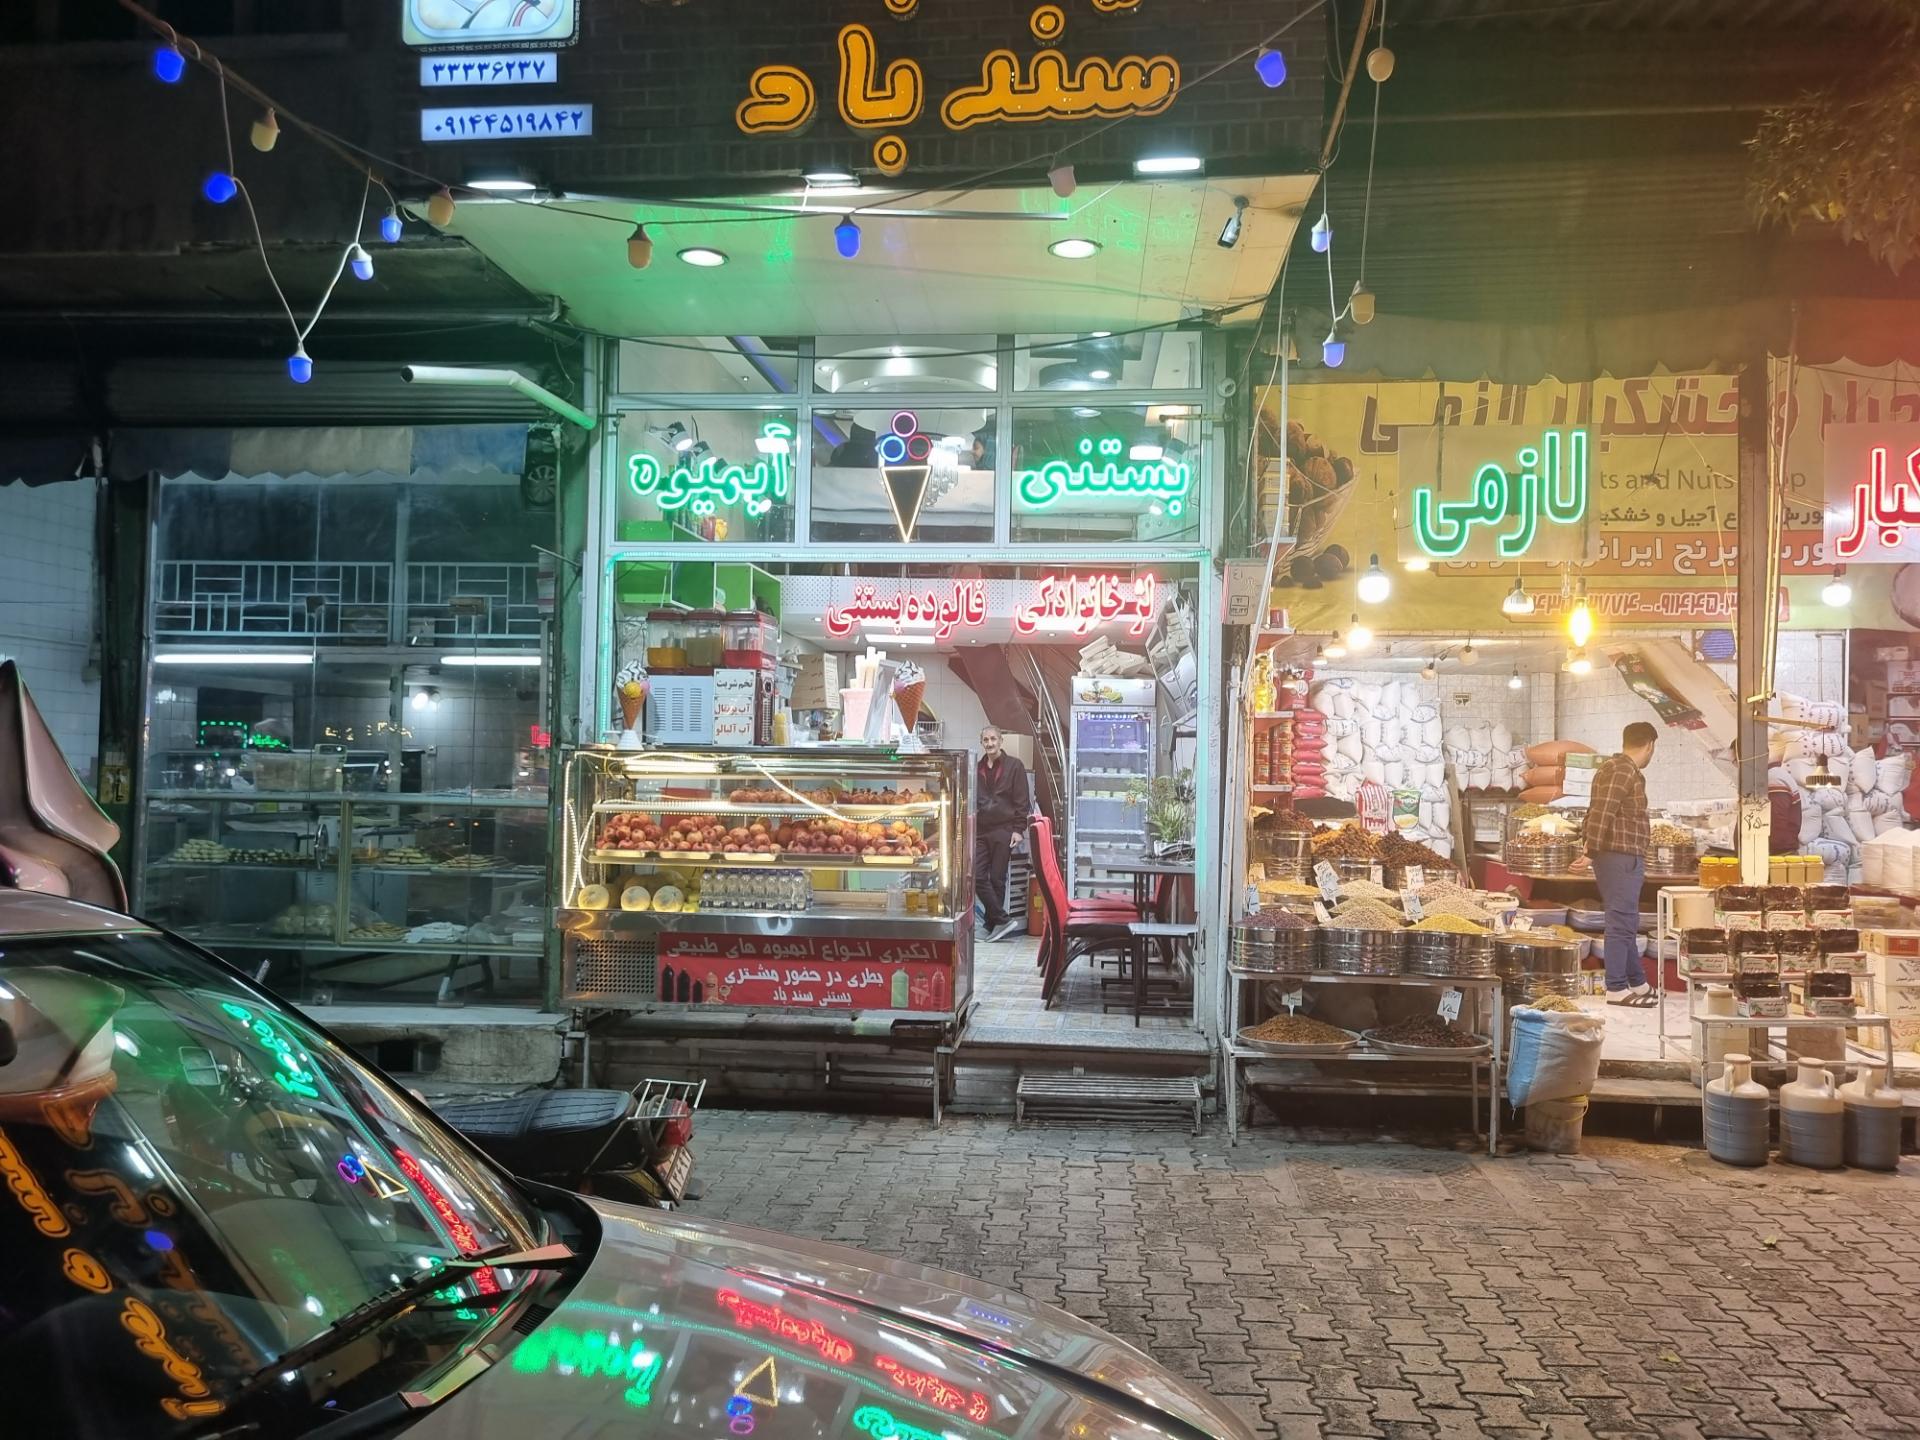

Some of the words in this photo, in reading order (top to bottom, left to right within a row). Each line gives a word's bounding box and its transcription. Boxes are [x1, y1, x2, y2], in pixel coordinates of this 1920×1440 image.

[435, 110, 583, 135] ۰۹۱۴۴۵۱۹۸۴۲
[1018, 438, 1192, 517] بستنی
[1413, 428, 1589, 558] لازمی
[739, 724, 751, 736] آب
[666, 936, 718, 957] طبیعی
[725, 937, 754, 958] های
[724, 963, 780, 985] مشتری
[783, 966, 821, 986] حضور
[825, 970, 843, 987] در
[847, 967, 884, 987] بطری
[818, 991, 853, 1007] بستنی
